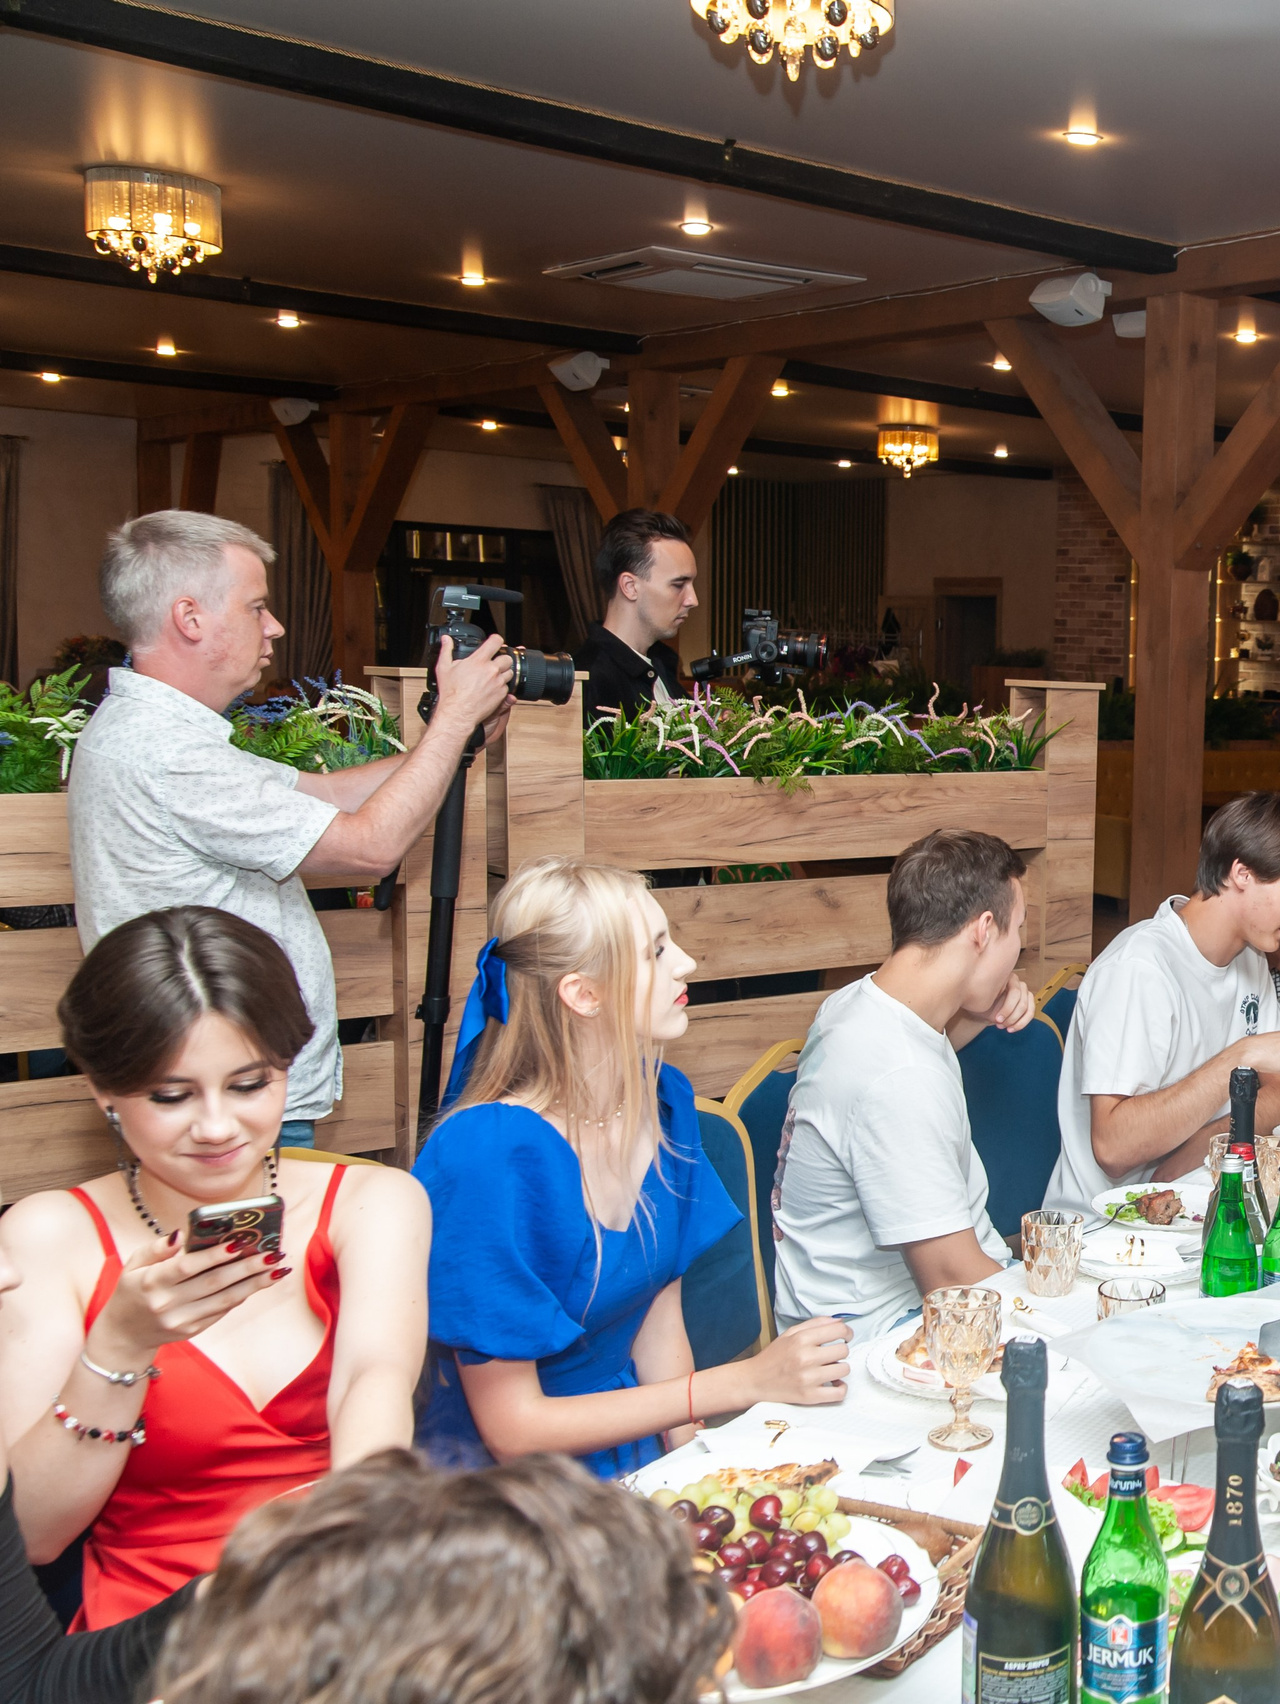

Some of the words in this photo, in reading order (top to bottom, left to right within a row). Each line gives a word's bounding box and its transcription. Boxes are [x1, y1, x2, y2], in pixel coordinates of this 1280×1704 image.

[732, 653, 753, 664] RONIN
[1226, 1474, 1244, 1527] 1870
[1087, 1642, 1154, 1669] JERMUK
